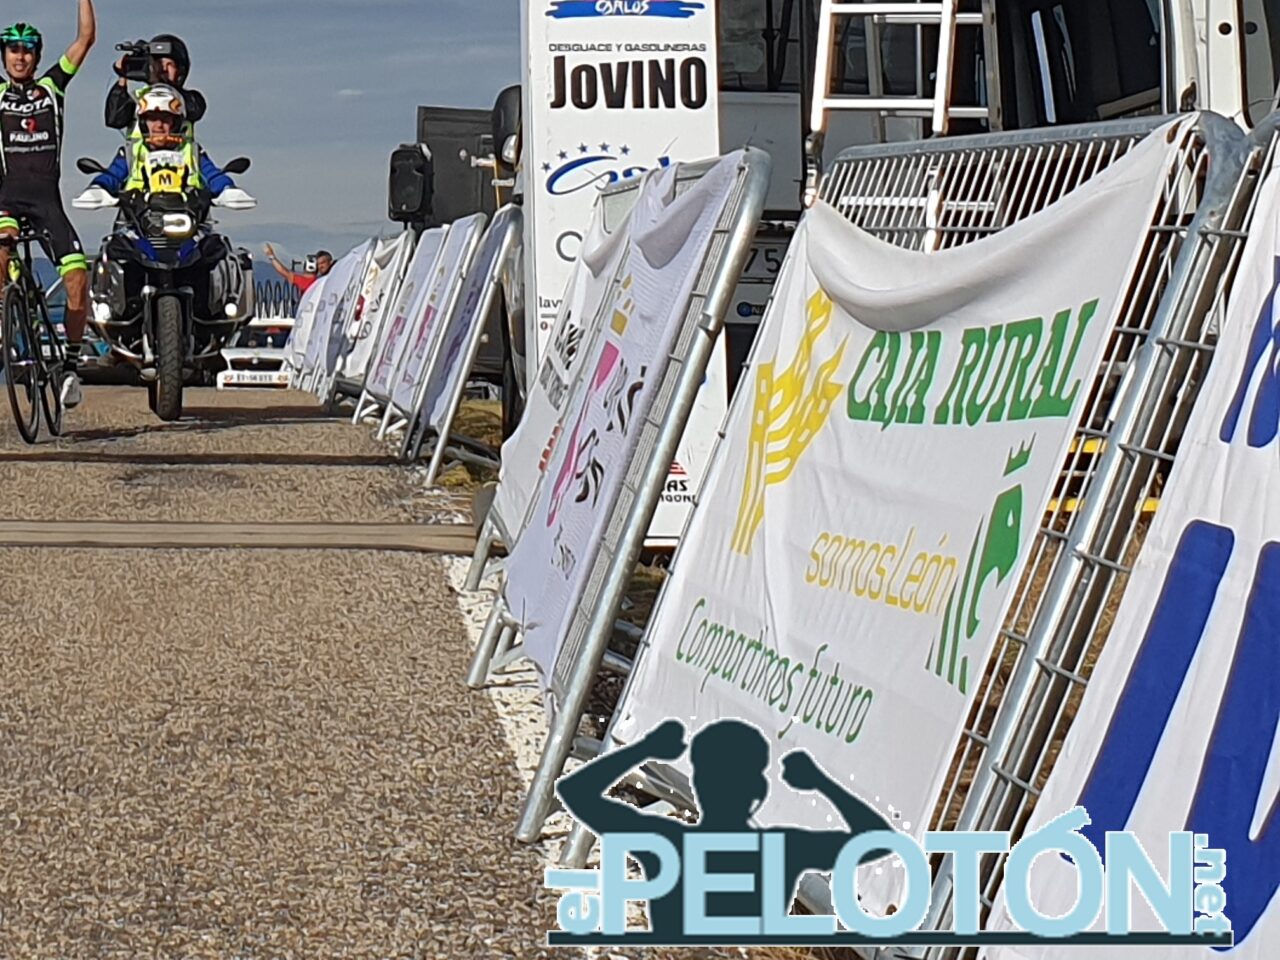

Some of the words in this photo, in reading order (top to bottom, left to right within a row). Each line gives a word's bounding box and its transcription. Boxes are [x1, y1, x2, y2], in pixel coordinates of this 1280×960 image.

[595, 0, 650, 16] CARLOS
[549, 43, 613, 52] DESGUACE
[616, 43, 622, 52] Y
[624, 43, 707, 52] GASOLINERAS
[159, 174, 172, 186] M
[846, 329, 943, 432] CAJA
[936, 299, 1100, 427] RURAL
[676, 598, 804, 712] Compartimos
[778, 644, 873, 743] futuro
